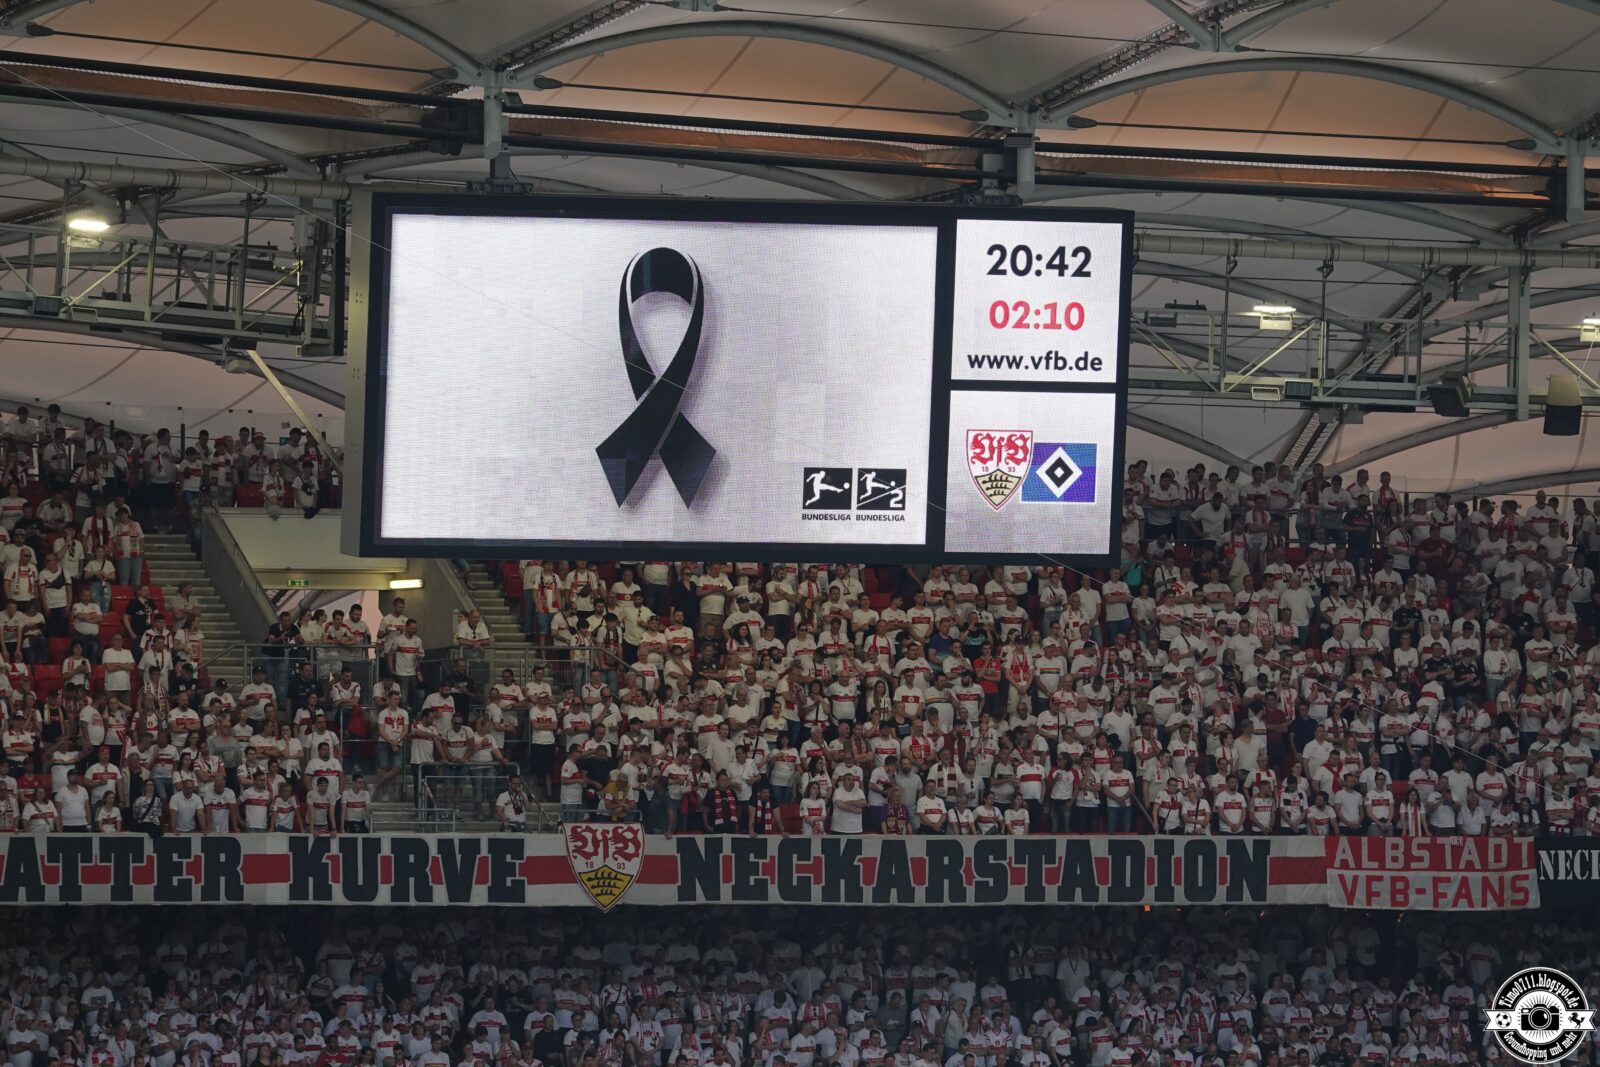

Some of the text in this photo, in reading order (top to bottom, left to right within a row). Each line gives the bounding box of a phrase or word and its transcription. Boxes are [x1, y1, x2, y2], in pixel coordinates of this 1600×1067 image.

[986, 244, 1092, 278] 20:42
[989, 300, 1085, 331] 02:10
[967, 351, 1103, 371] www.vfb.de
[890, 489, 903, 508] 2
[802, 513, 851, 521] BUNDESLIGA
[585, 861, 625, 870] 18 93
[1334, 836, 1535, 870] ALBSTADT
[289, 837, 526, 903] KURVE
[676, 837, 1271, 903] NECKARSTADION
[1337, 873, 1530, 909] VFB-FANS
